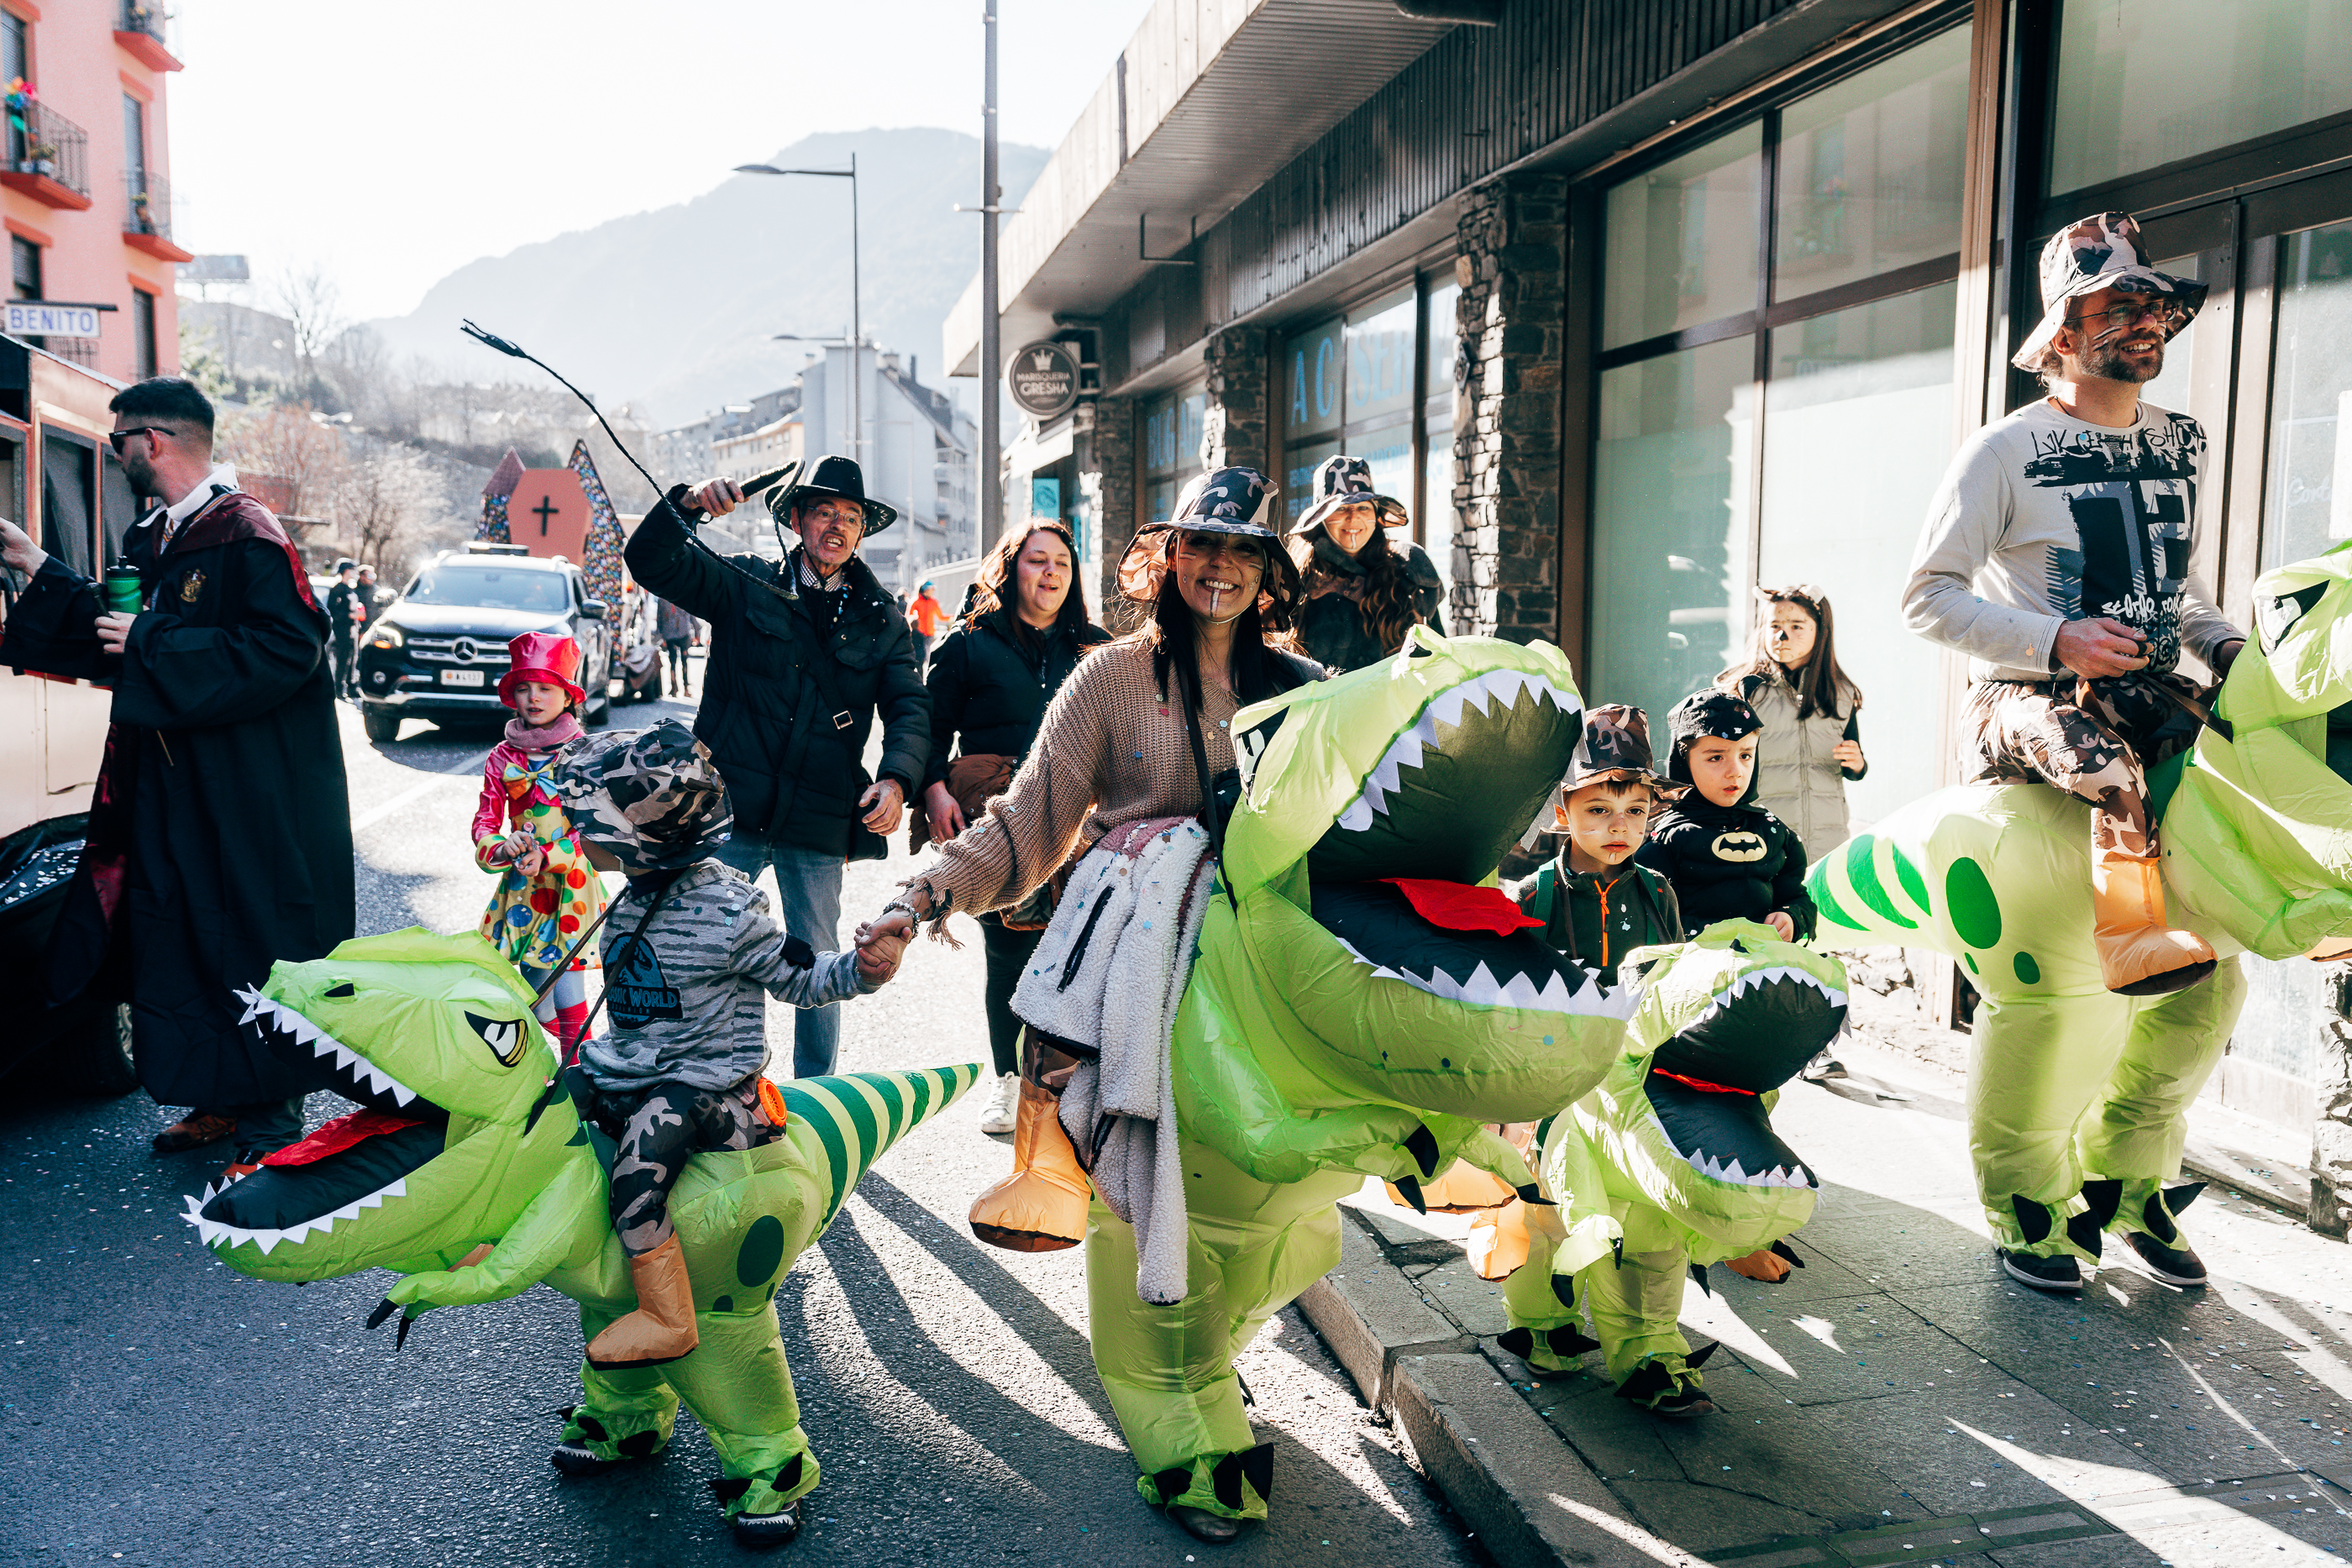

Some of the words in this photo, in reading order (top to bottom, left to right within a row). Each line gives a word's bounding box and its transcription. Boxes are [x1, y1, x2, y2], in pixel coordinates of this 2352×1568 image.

[10, 307, 93, 333] BENITO
[1016, 371, 1071, 382] MARISQUERIA
[628, 987, 677, 1008] WORLD
